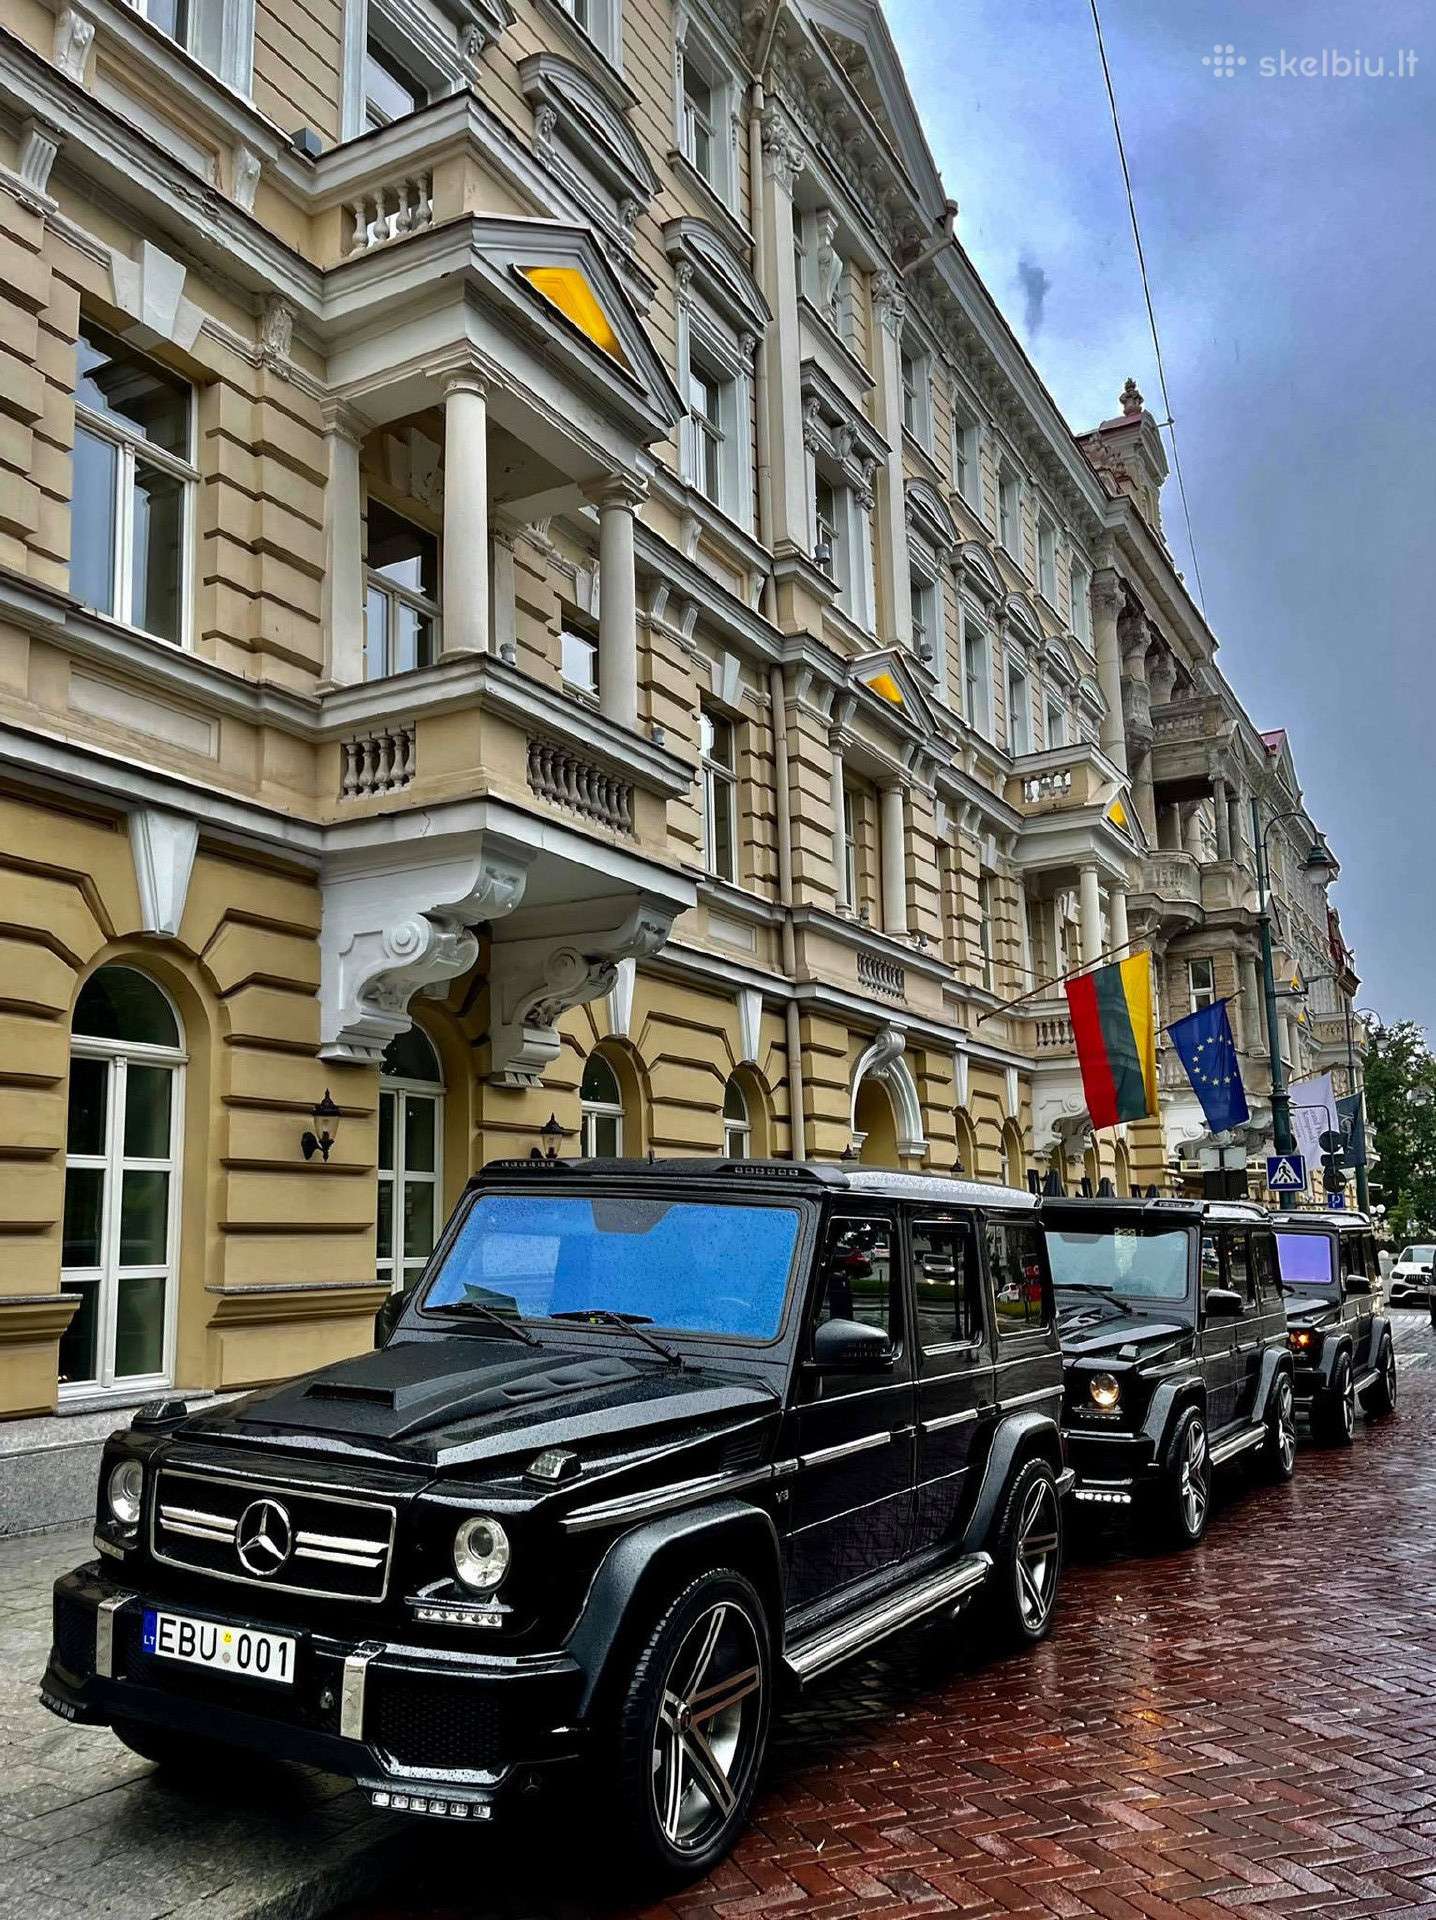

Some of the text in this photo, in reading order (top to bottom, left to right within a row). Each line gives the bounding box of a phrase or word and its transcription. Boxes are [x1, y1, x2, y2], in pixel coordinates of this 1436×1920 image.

[143, 1635, 156, 1646] LT
[158, 1617, 287, 1677] EBU 001
